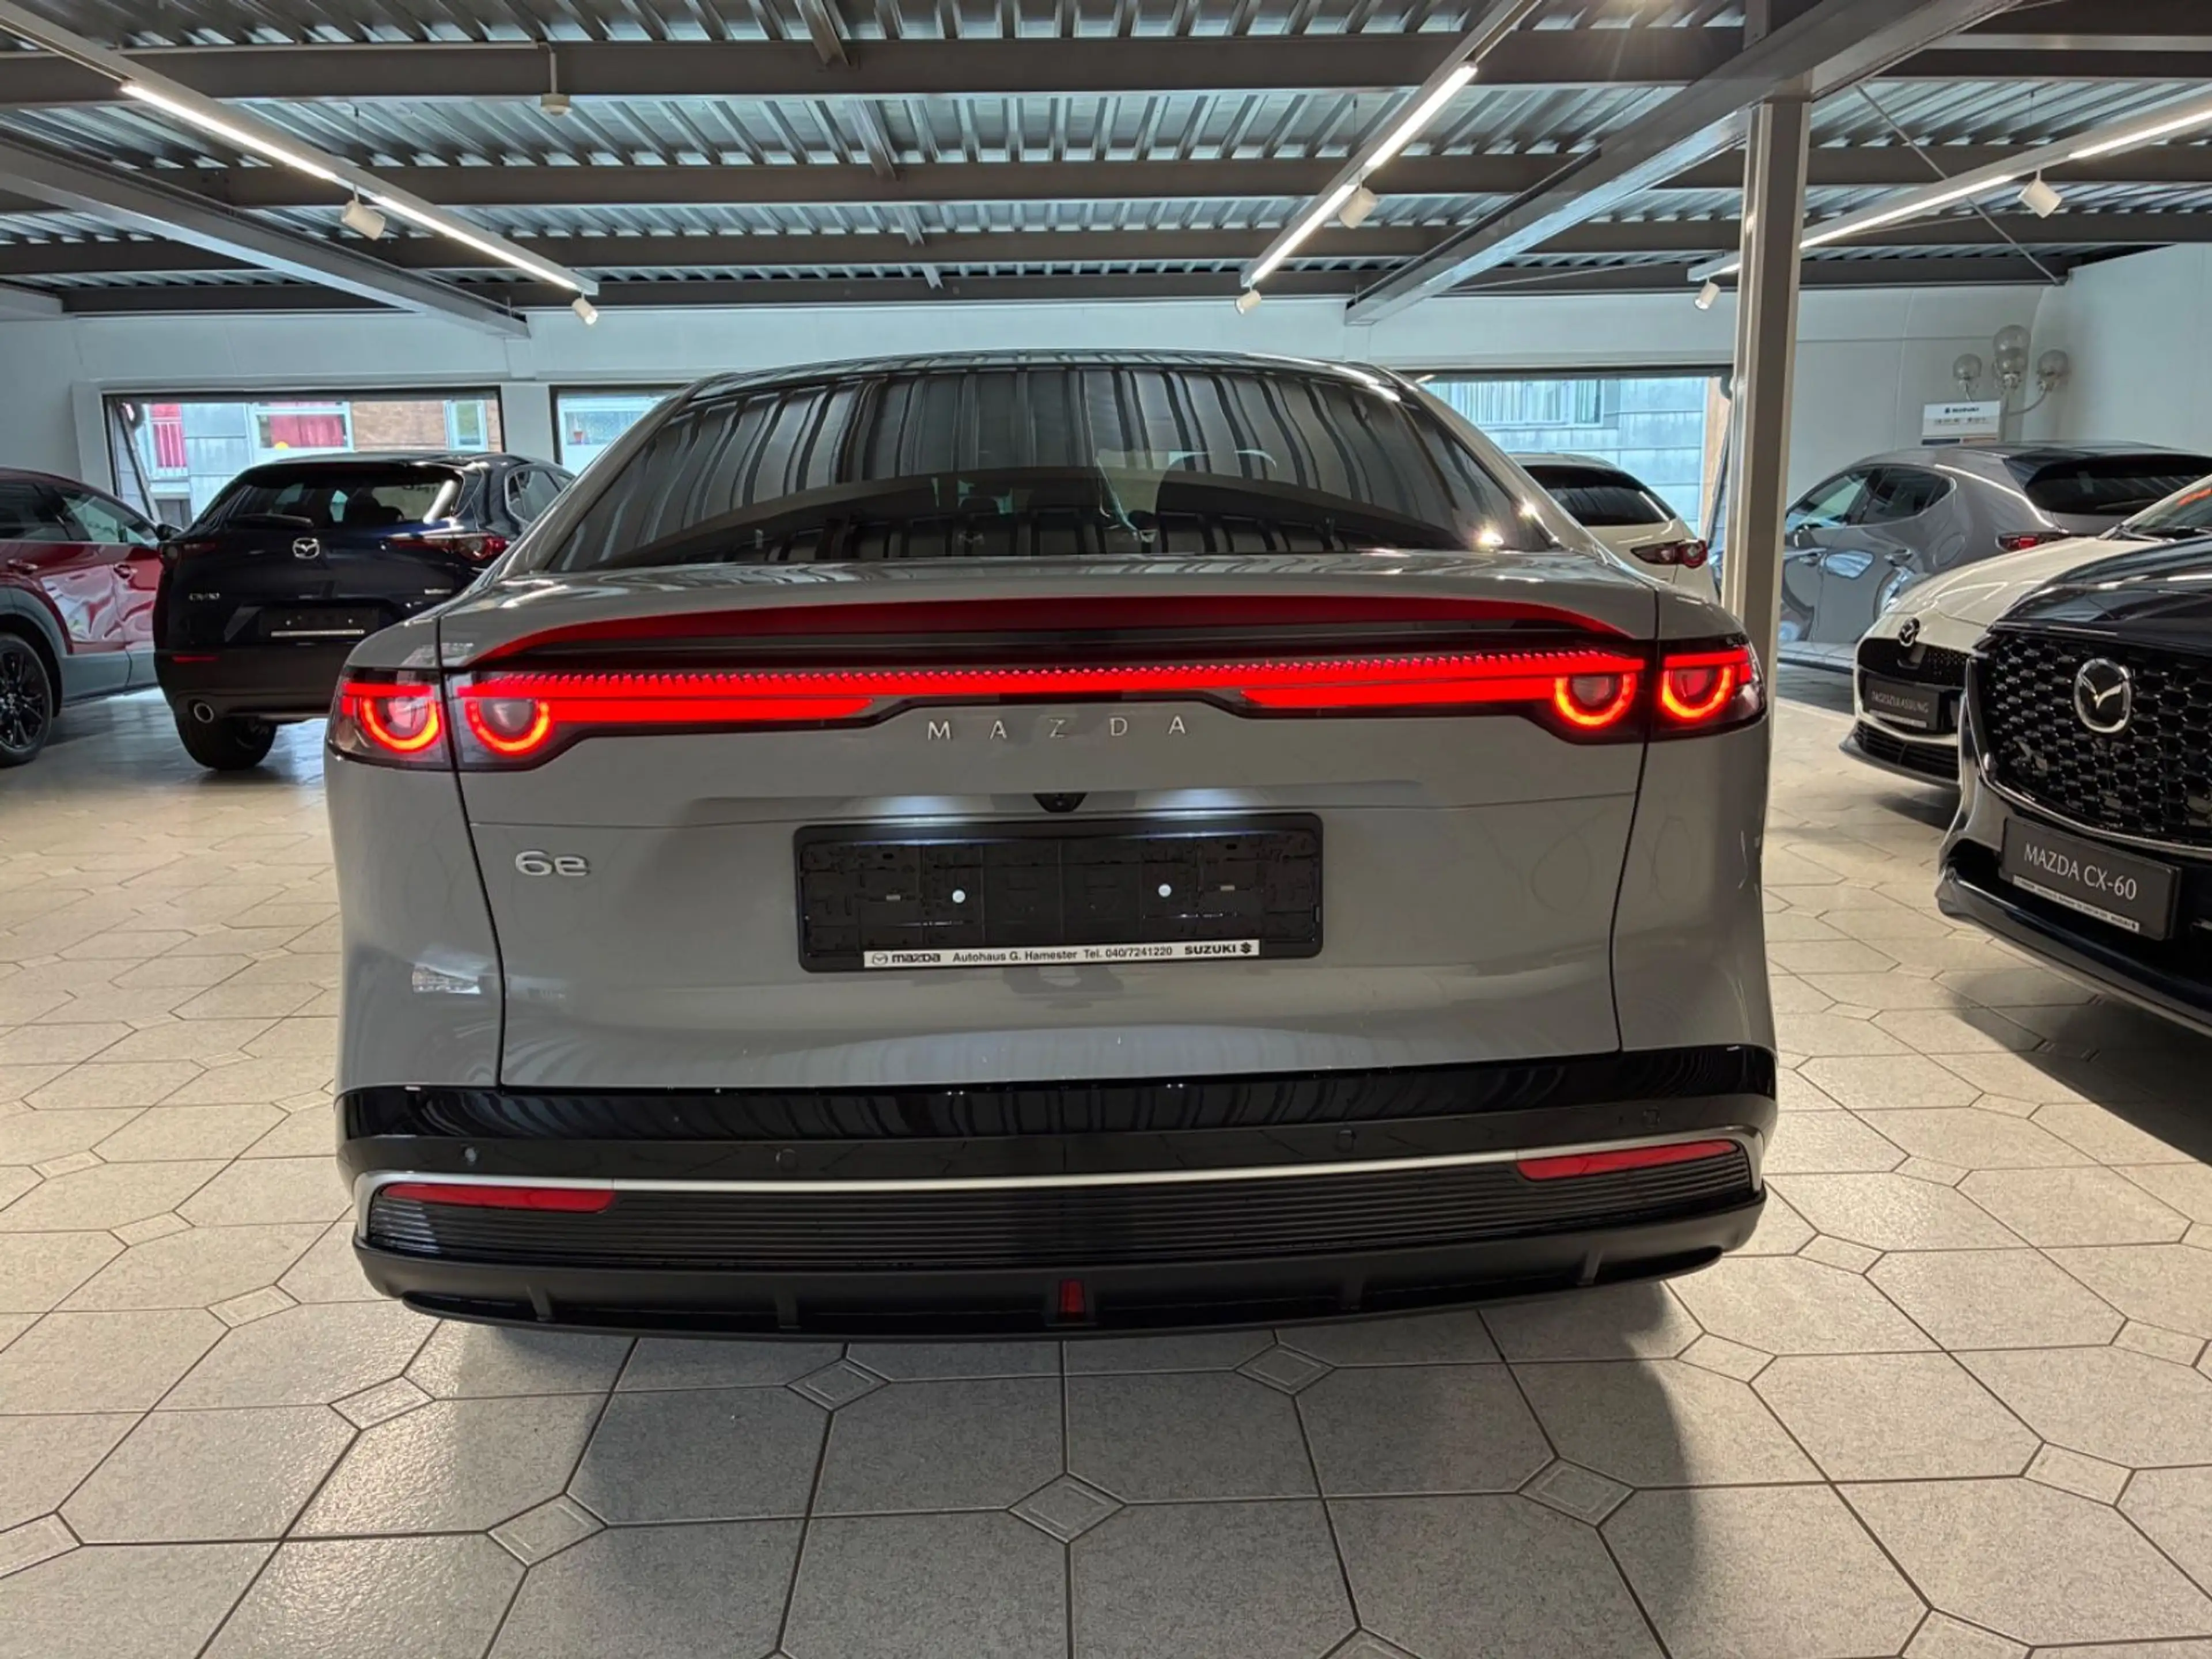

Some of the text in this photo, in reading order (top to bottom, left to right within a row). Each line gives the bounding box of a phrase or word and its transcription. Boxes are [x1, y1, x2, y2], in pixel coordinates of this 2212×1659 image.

[927, 715, 1186, 741] MAZDA
[515, 850, 587, 876] 6e
[2024, 842, 2137, 901] MAZDA CX-60
[952, 951, 1006, 963] Autohaus
[1009, 950, 1021, 961] G.
[1025, 950, 1077, 961] Hamester
[1084, 949, 1101, 959] Tel.
[1105, 946, 1173, 958] 040/7241220
[1184, 944, 1236, 955] SUZUKI
